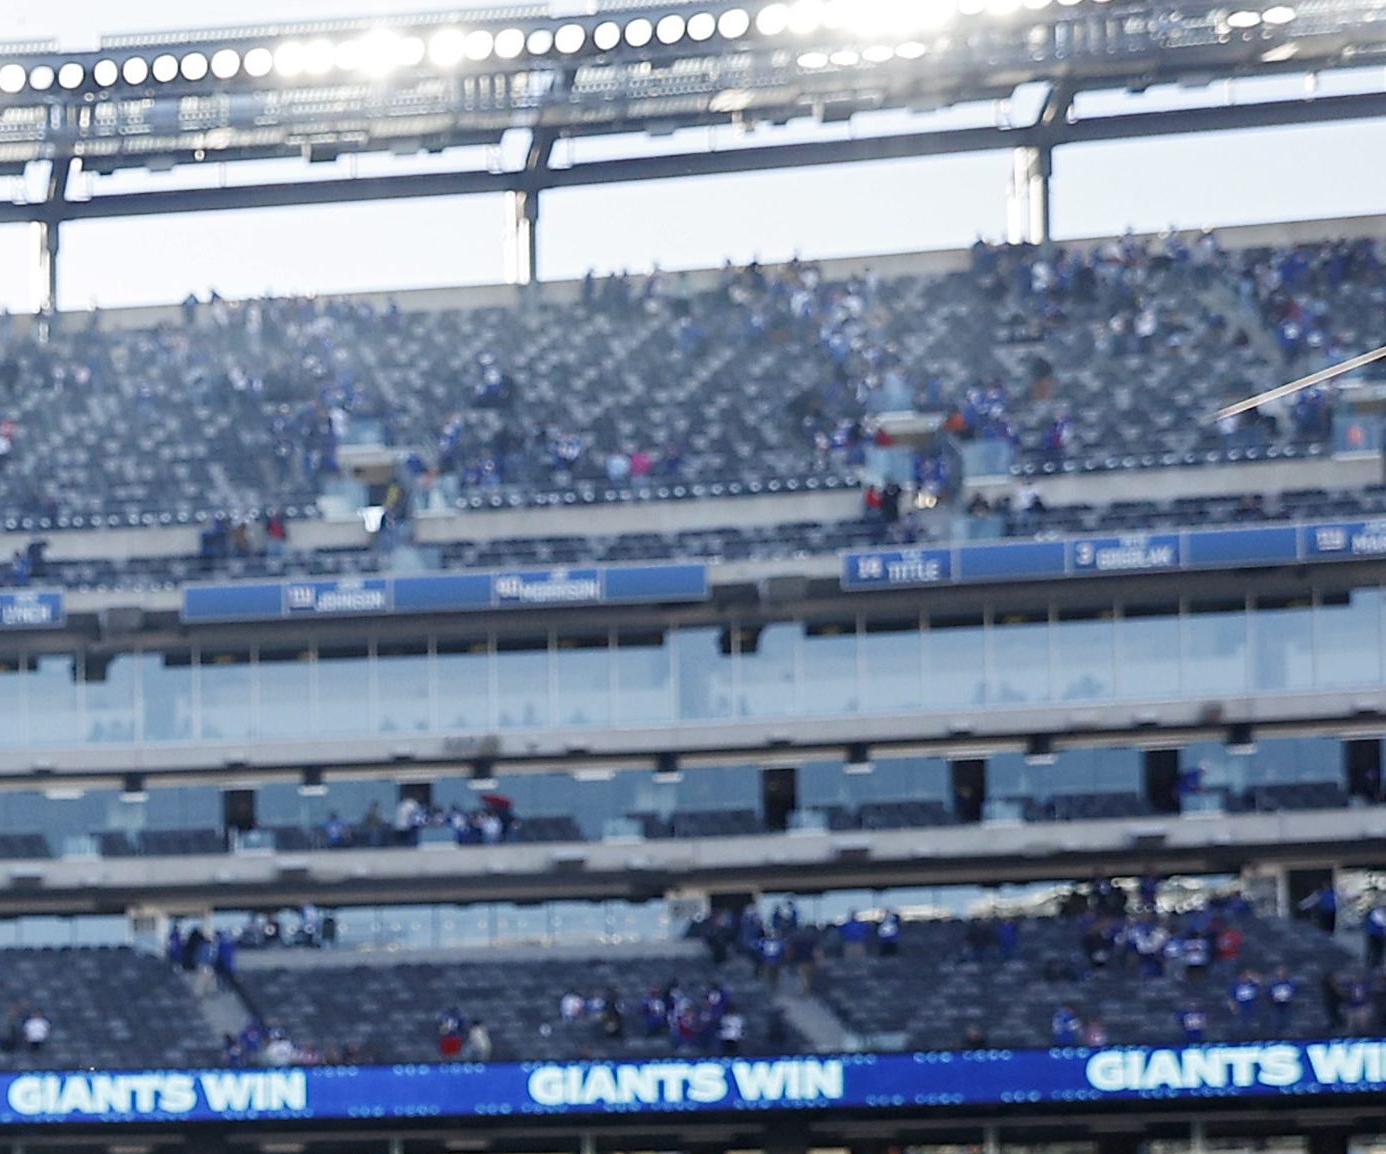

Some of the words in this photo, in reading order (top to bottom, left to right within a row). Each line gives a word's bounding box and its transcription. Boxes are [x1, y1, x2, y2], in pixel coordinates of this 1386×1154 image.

[528, 1062, 727, 1105] GIANTS
[731, 1060, 843, 1100] WIN
[1086, 1044, 1303, 1091] GIANTS
[1305, 1042, 1386, 1084] WI
[8, 1073, 196, 1115] GIANTS
[199, 1071, 307, 1112] WIN
